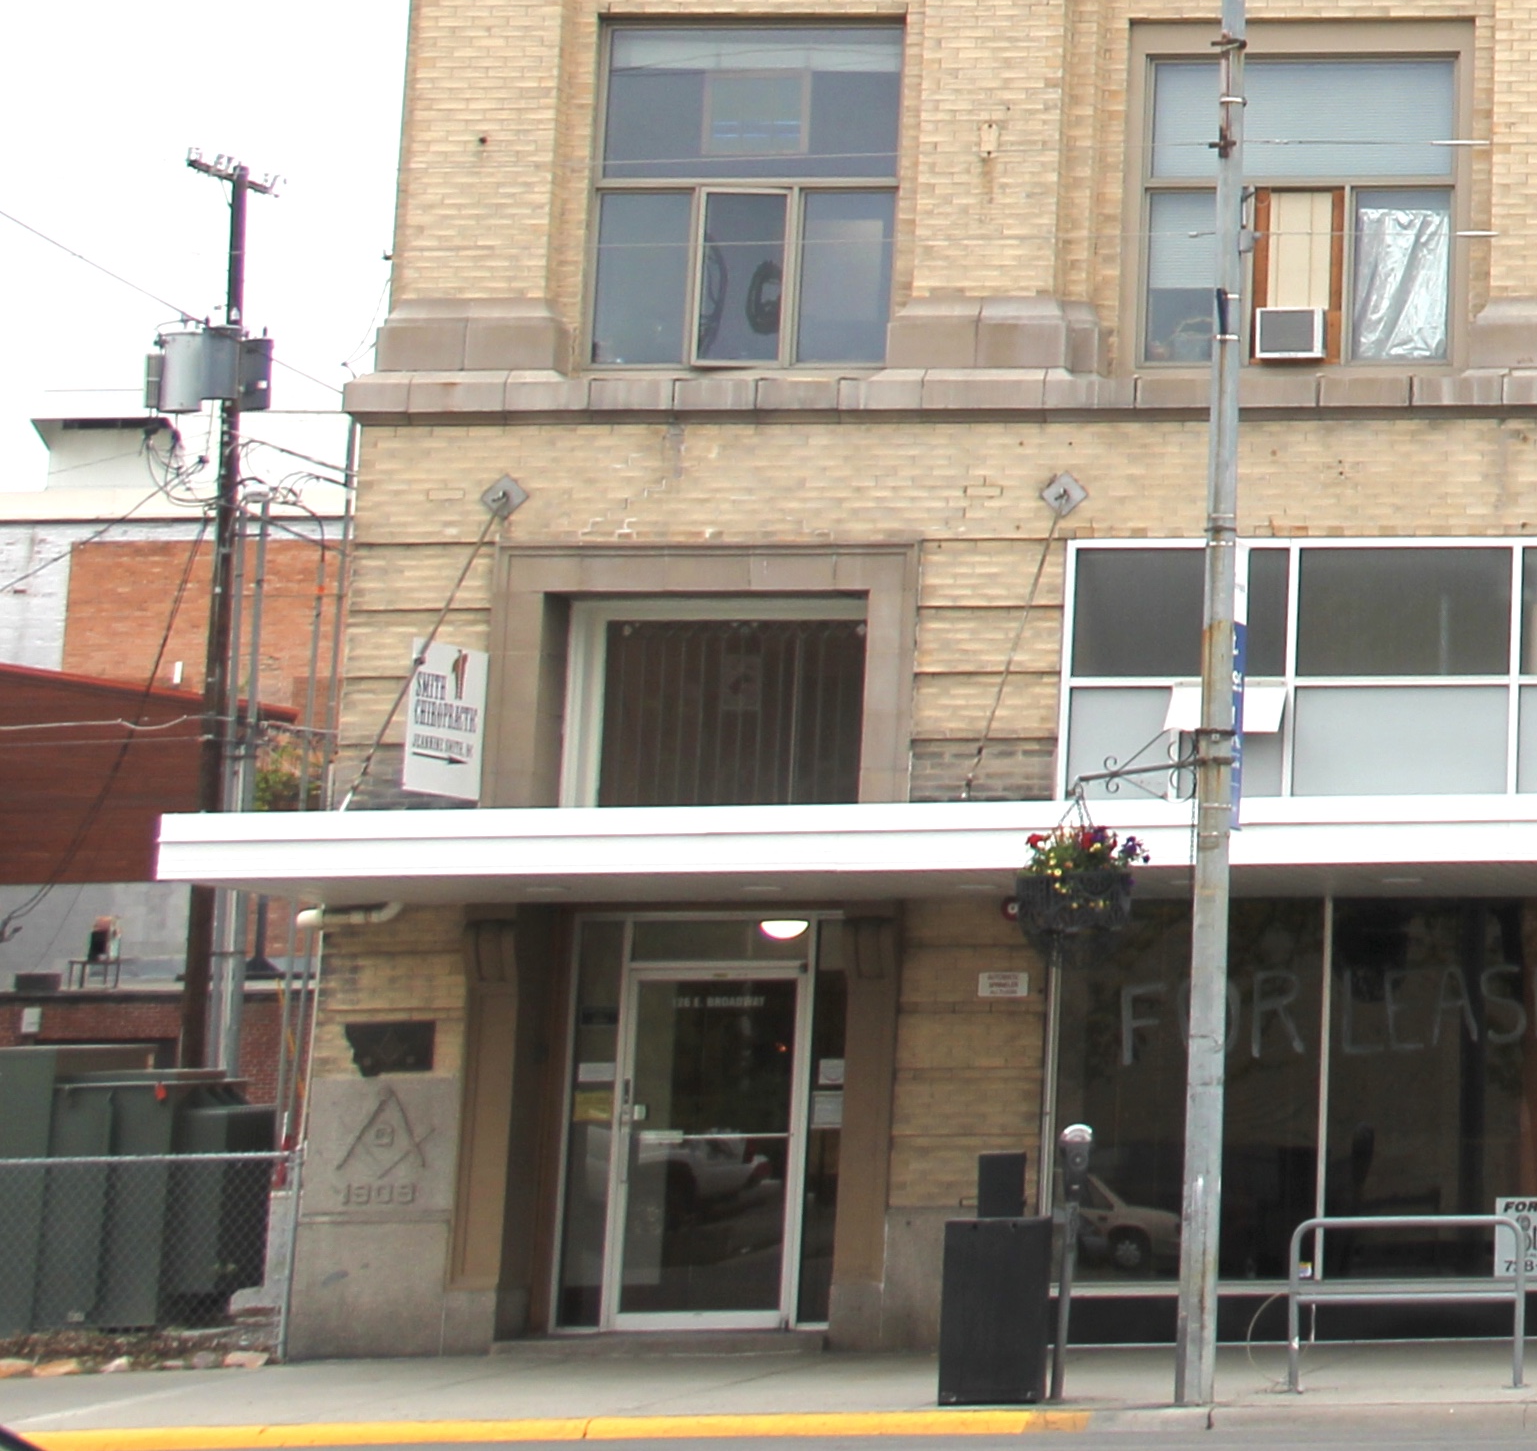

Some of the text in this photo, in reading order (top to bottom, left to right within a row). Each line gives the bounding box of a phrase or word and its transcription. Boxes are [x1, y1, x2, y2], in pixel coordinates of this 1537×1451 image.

[416, 671, 447, 700] SMITH
[414, 699, 478, 733] CHIROPRACTIC
[672, 996, 691, 1008] 126
[706, 996, 766, 1008] BROADWAY
